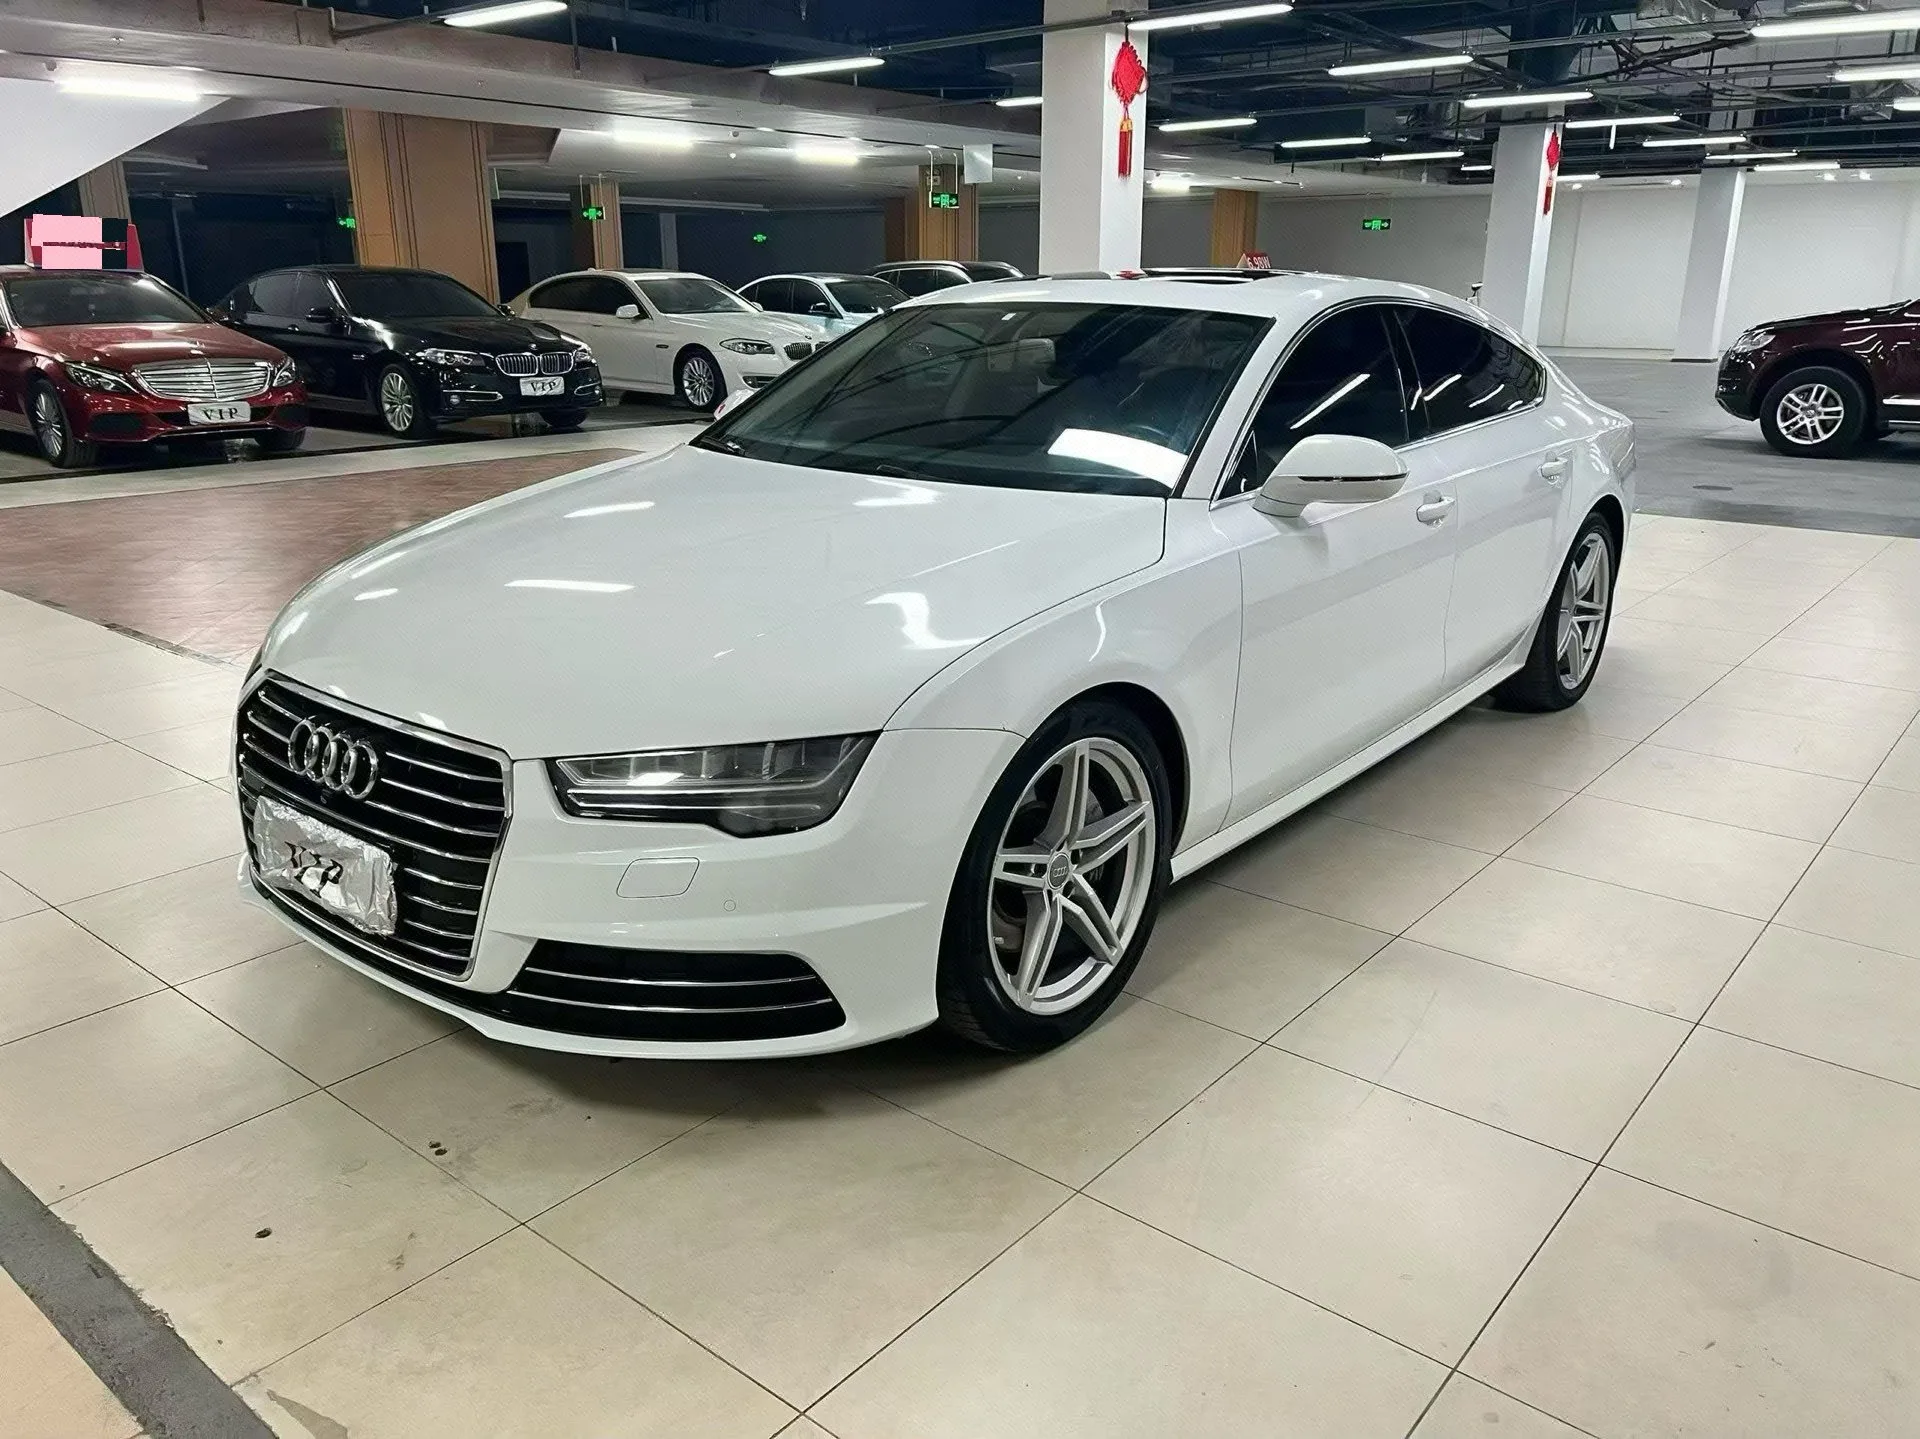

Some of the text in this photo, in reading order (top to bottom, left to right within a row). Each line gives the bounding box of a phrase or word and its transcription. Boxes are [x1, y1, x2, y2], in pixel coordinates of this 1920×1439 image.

[530, 381, 556, 391] VIP
[202, 407, 238, 420] VIP
[285, 841, 343, 898] VIP
